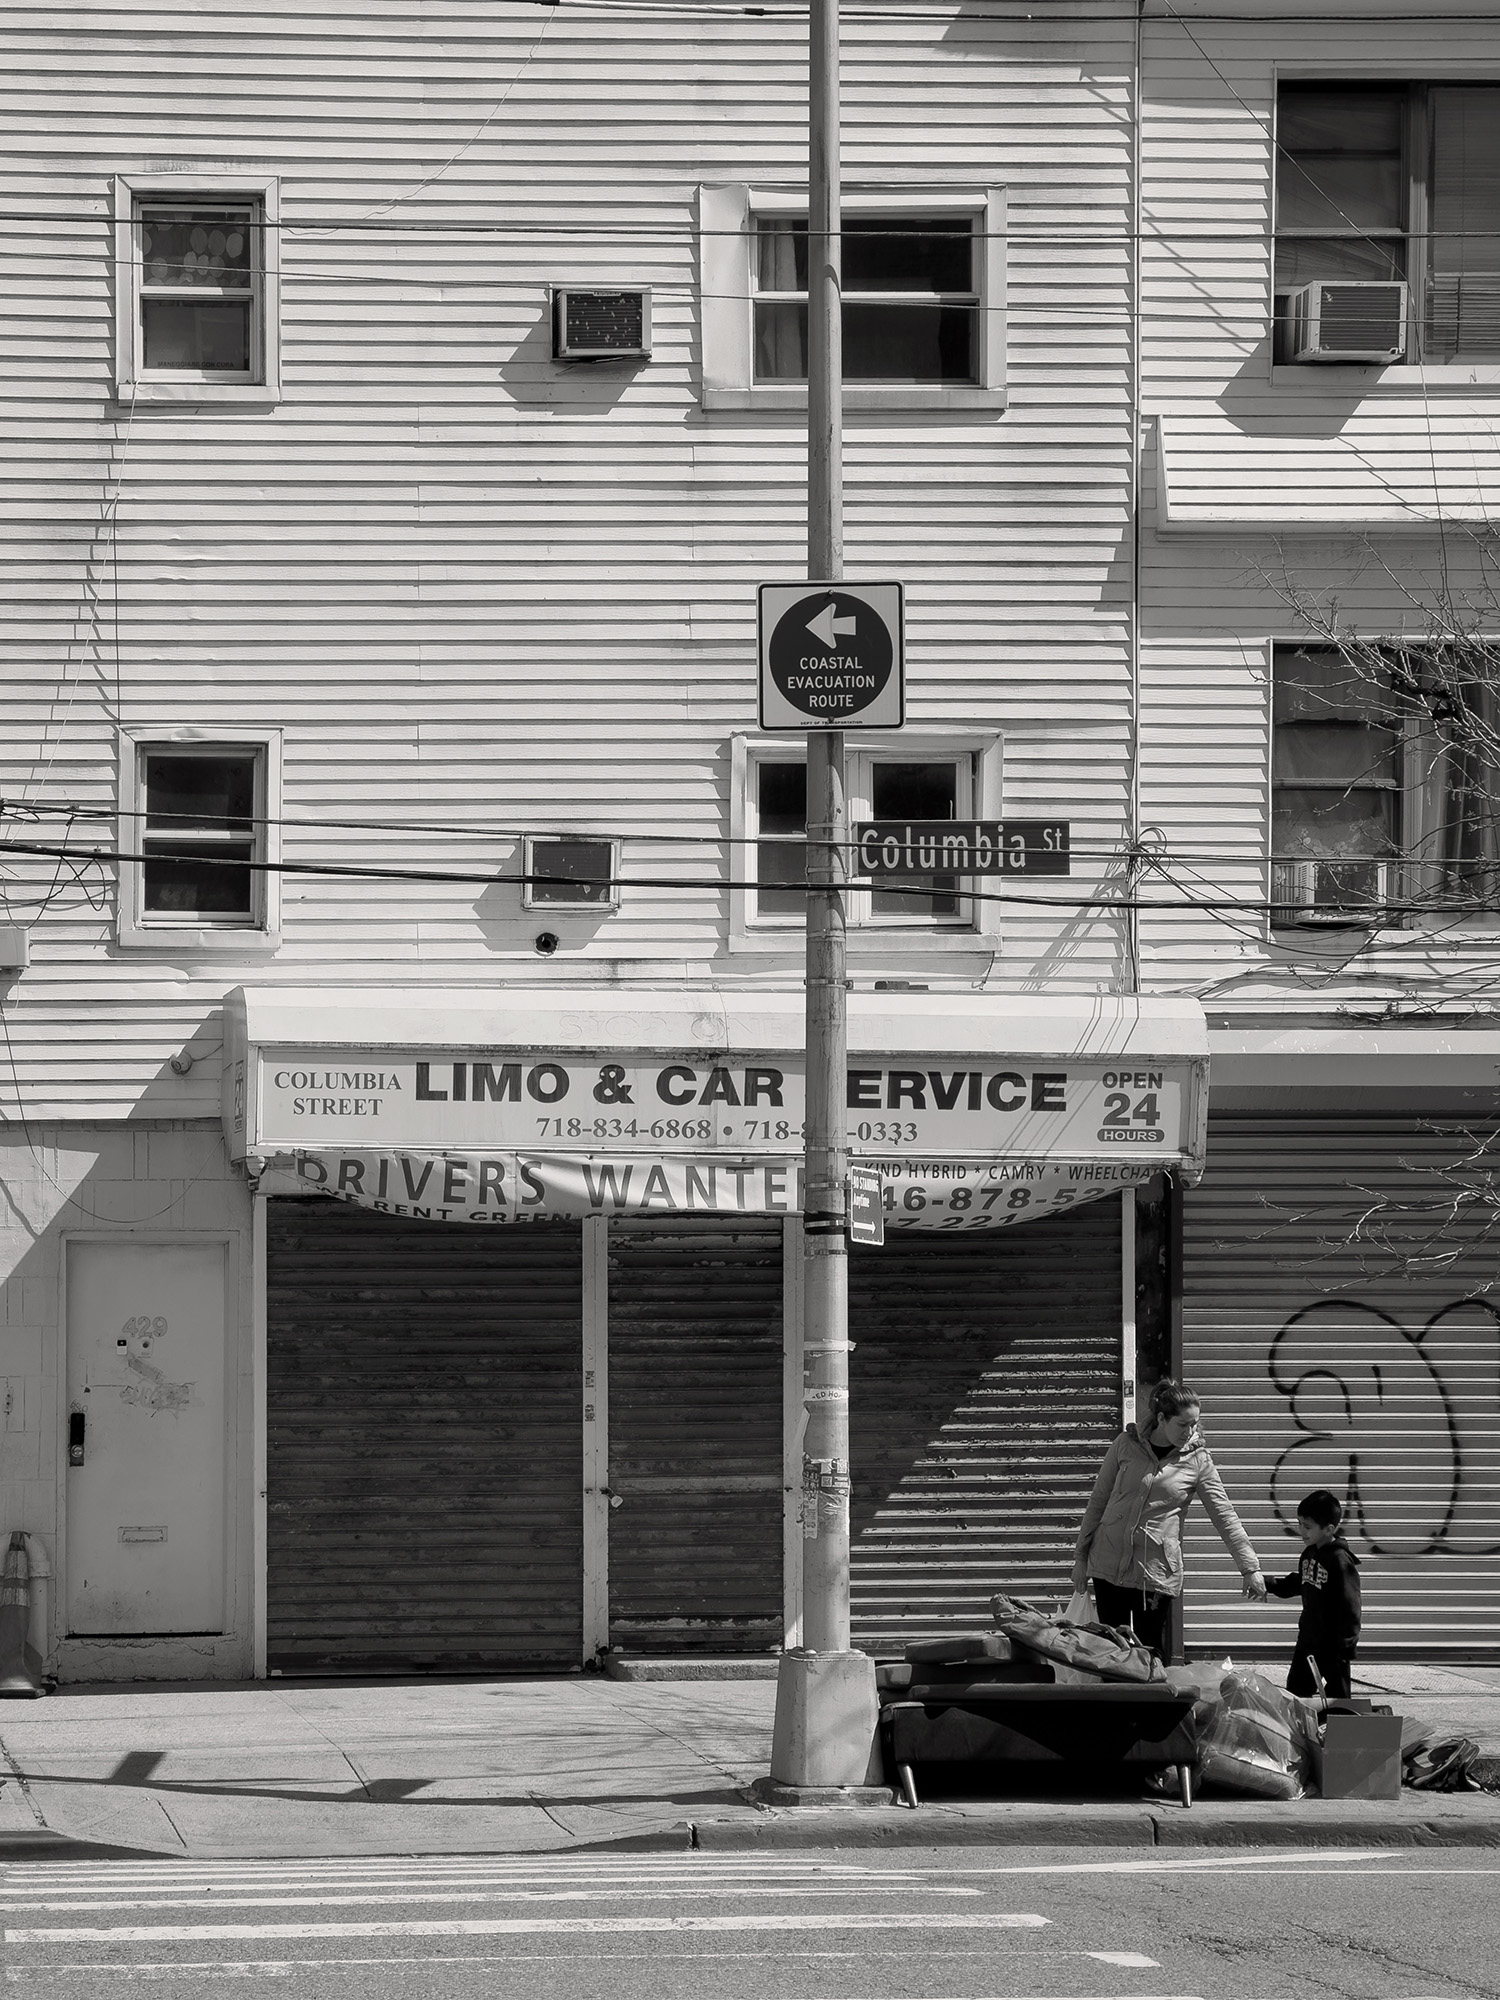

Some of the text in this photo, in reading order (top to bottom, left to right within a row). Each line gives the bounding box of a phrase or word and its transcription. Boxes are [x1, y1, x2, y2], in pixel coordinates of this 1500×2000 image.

[800, 656, 863, 670] COASTAL
[787, 675, 875, 689] EVACUATION
[809, 694, 854, 708] ROUTE
[861, 824, 1062, 869] Columbia St
[274, 1070, 402, 1091] COLUMBIA
[416, 1061, 1067, 1112] LIMO & CAR ERVICE
[1102, 1072, 1163, 1089] OPEN
[293, 1097, 383, 1116] STREET
[1103, 1093, 1161, 1126] 24
[536, 1117, 918, 1142] 718-834-6868 718--0333
[1104, 1131, 1157, 1141] HOURS
[909, 1163, 967, 1180] HYBRID
[989, 1165, 1046, 1180] CAMRY
[298, 1157, 805, 1211] DRIVERS WANTE
[883, 1186, 1106, 1212] 46-878-52
[374, 1200, 453, 1220] RENT
[122, 1316, 168, 1338] 429
